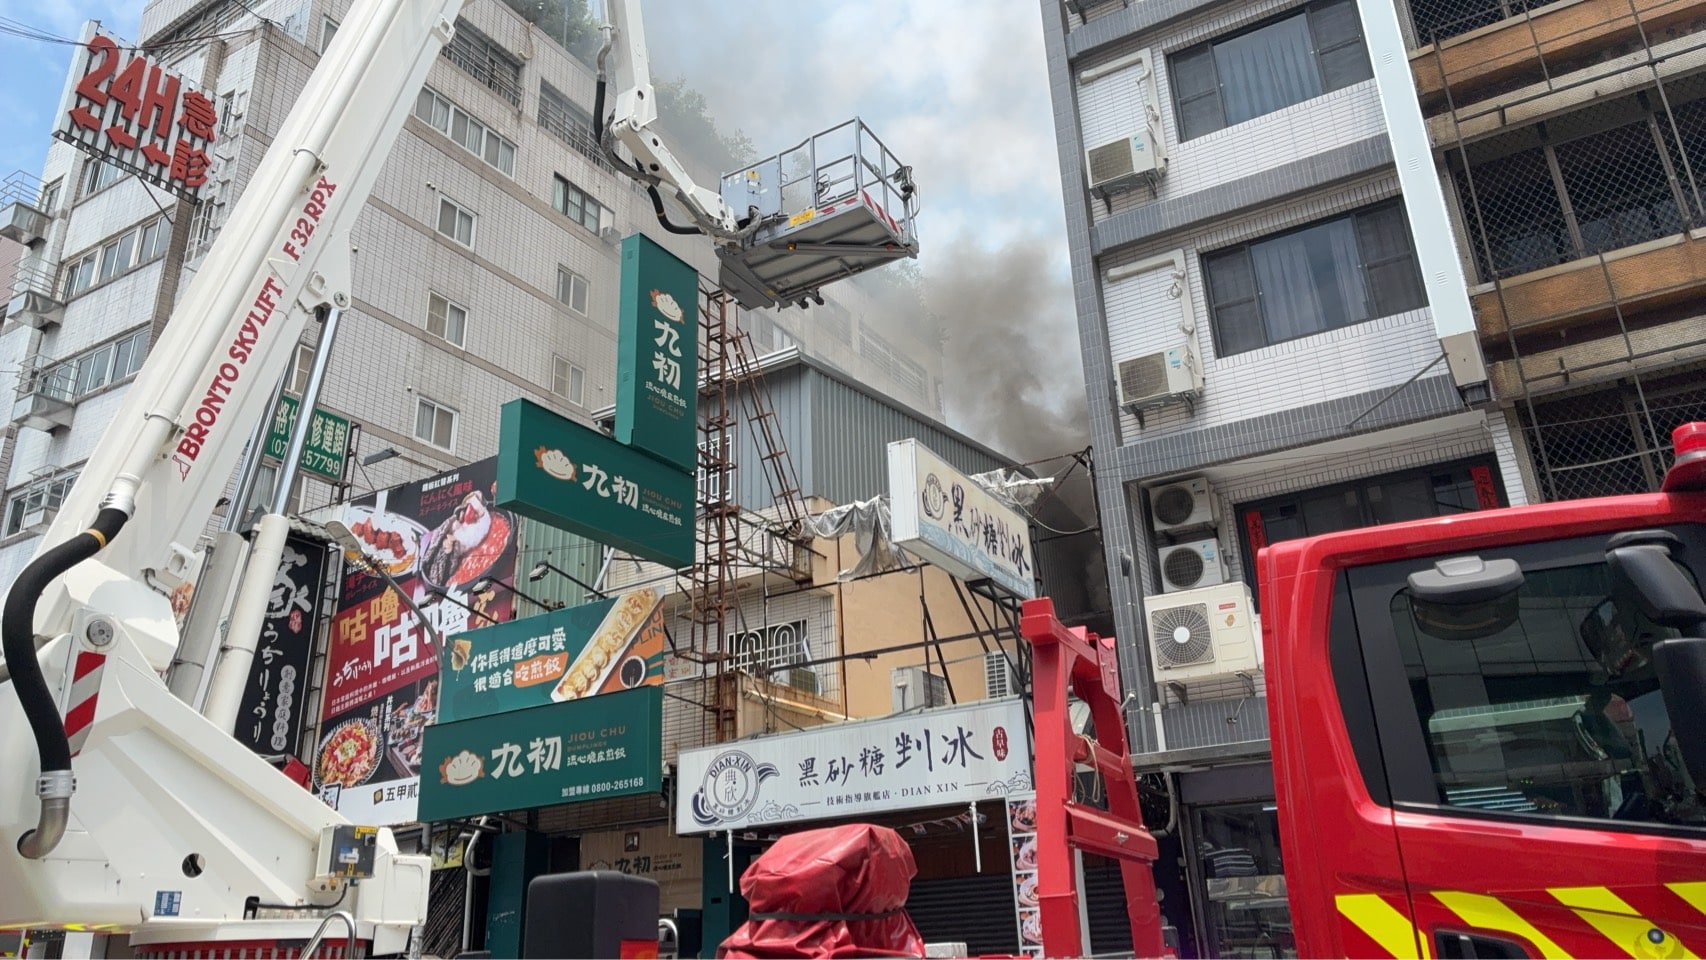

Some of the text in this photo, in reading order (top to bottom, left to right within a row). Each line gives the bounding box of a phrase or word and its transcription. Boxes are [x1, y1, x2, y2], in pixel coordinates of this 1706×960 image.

[76, 35, 180, 139] 24H
[169, 90, 218, 187] 急診
[283, 176, 337, 262] F 32 RPX
[176, 277, 284, 462] BRONTO SKYLIFT
[652, 320, 682, 391] 九初
[582, 463, 638, 511] 九初
[339, 584, 400, 647] 咕嚕
[470, 627, 566, 673] 你長得這麼可愛
[474, 657, 561, 693] 很適合吃煎餃
[491, 735, 562, 780] 九初
[567, 747, 626, 767] 流心脆皮煎餃
[568, 725, 626, 744] JIOU CHU
[591, 777, 644, 793] 0800-265168
[827, 782, 959, 806] 技術指導旗艦店 DIAN XIN
